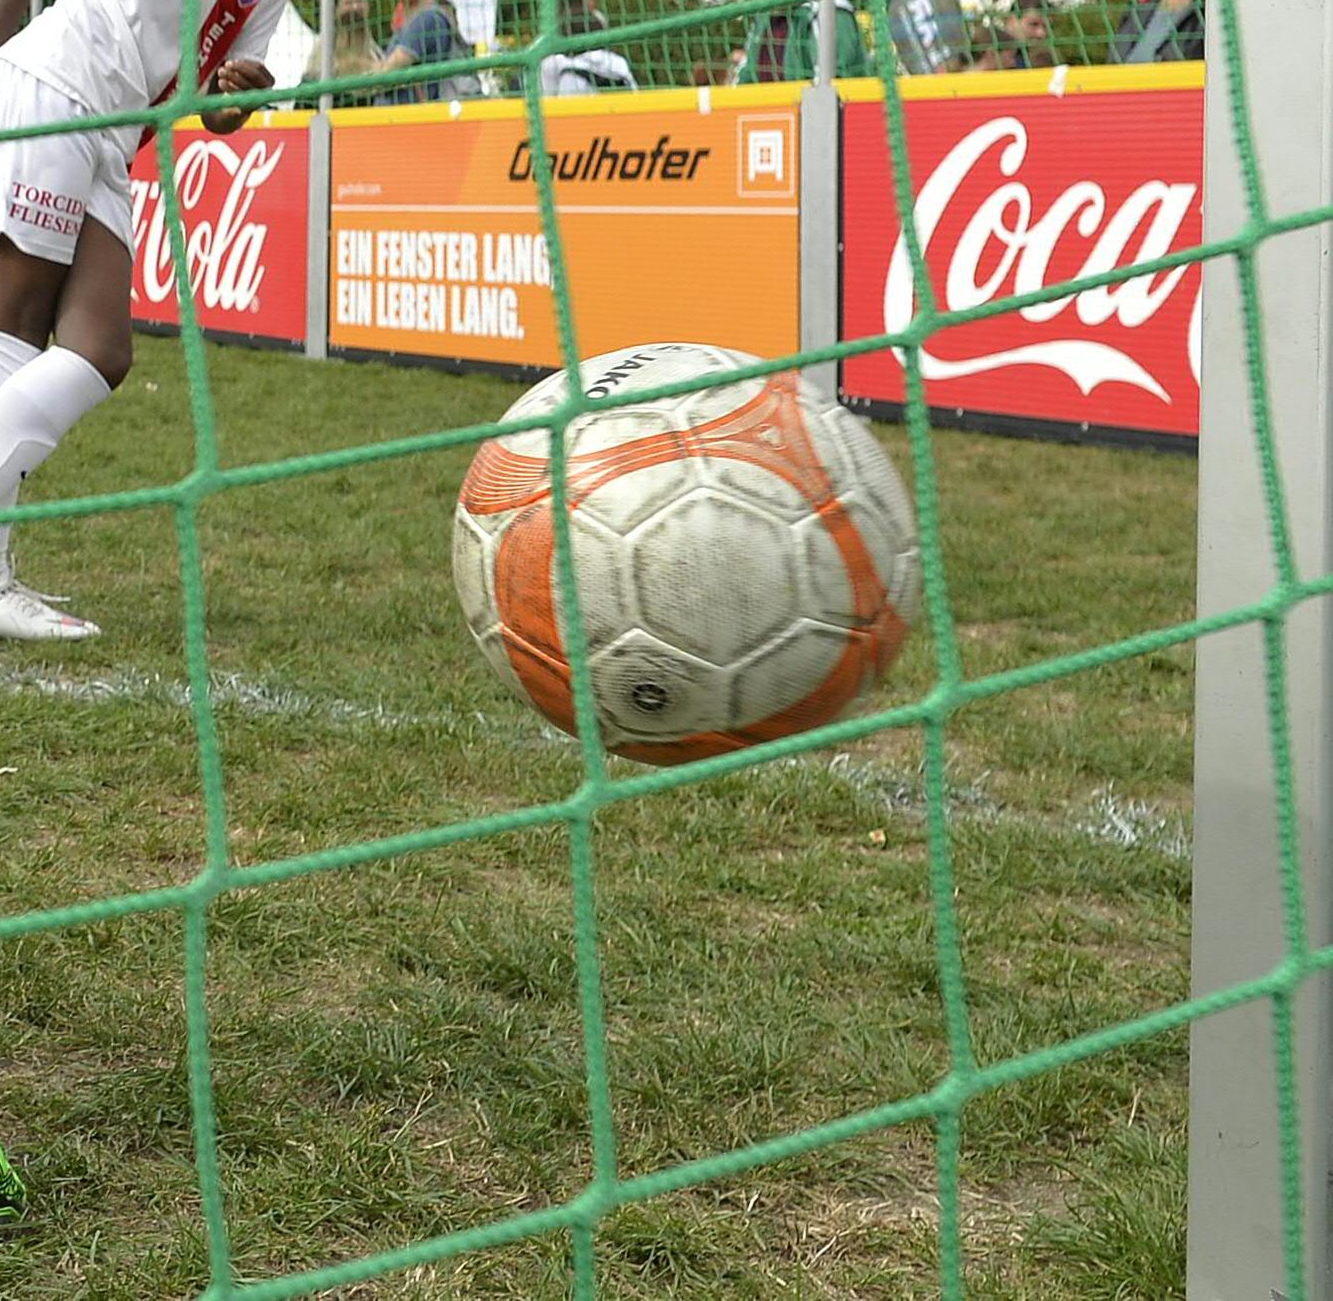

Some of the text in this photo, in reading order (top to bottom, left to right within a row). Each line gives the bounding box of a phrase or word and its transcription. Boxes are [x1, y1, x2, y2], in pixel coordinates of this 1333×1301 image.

[13, 181, 85, 216] TORCID
[337, 229, 373, 276] EIN
[376, 230, 478, 282] FENSTER
[337, 278, 525, 340] EIN LEBEN LANG.
[584, 353, 657, 401] JAKO
